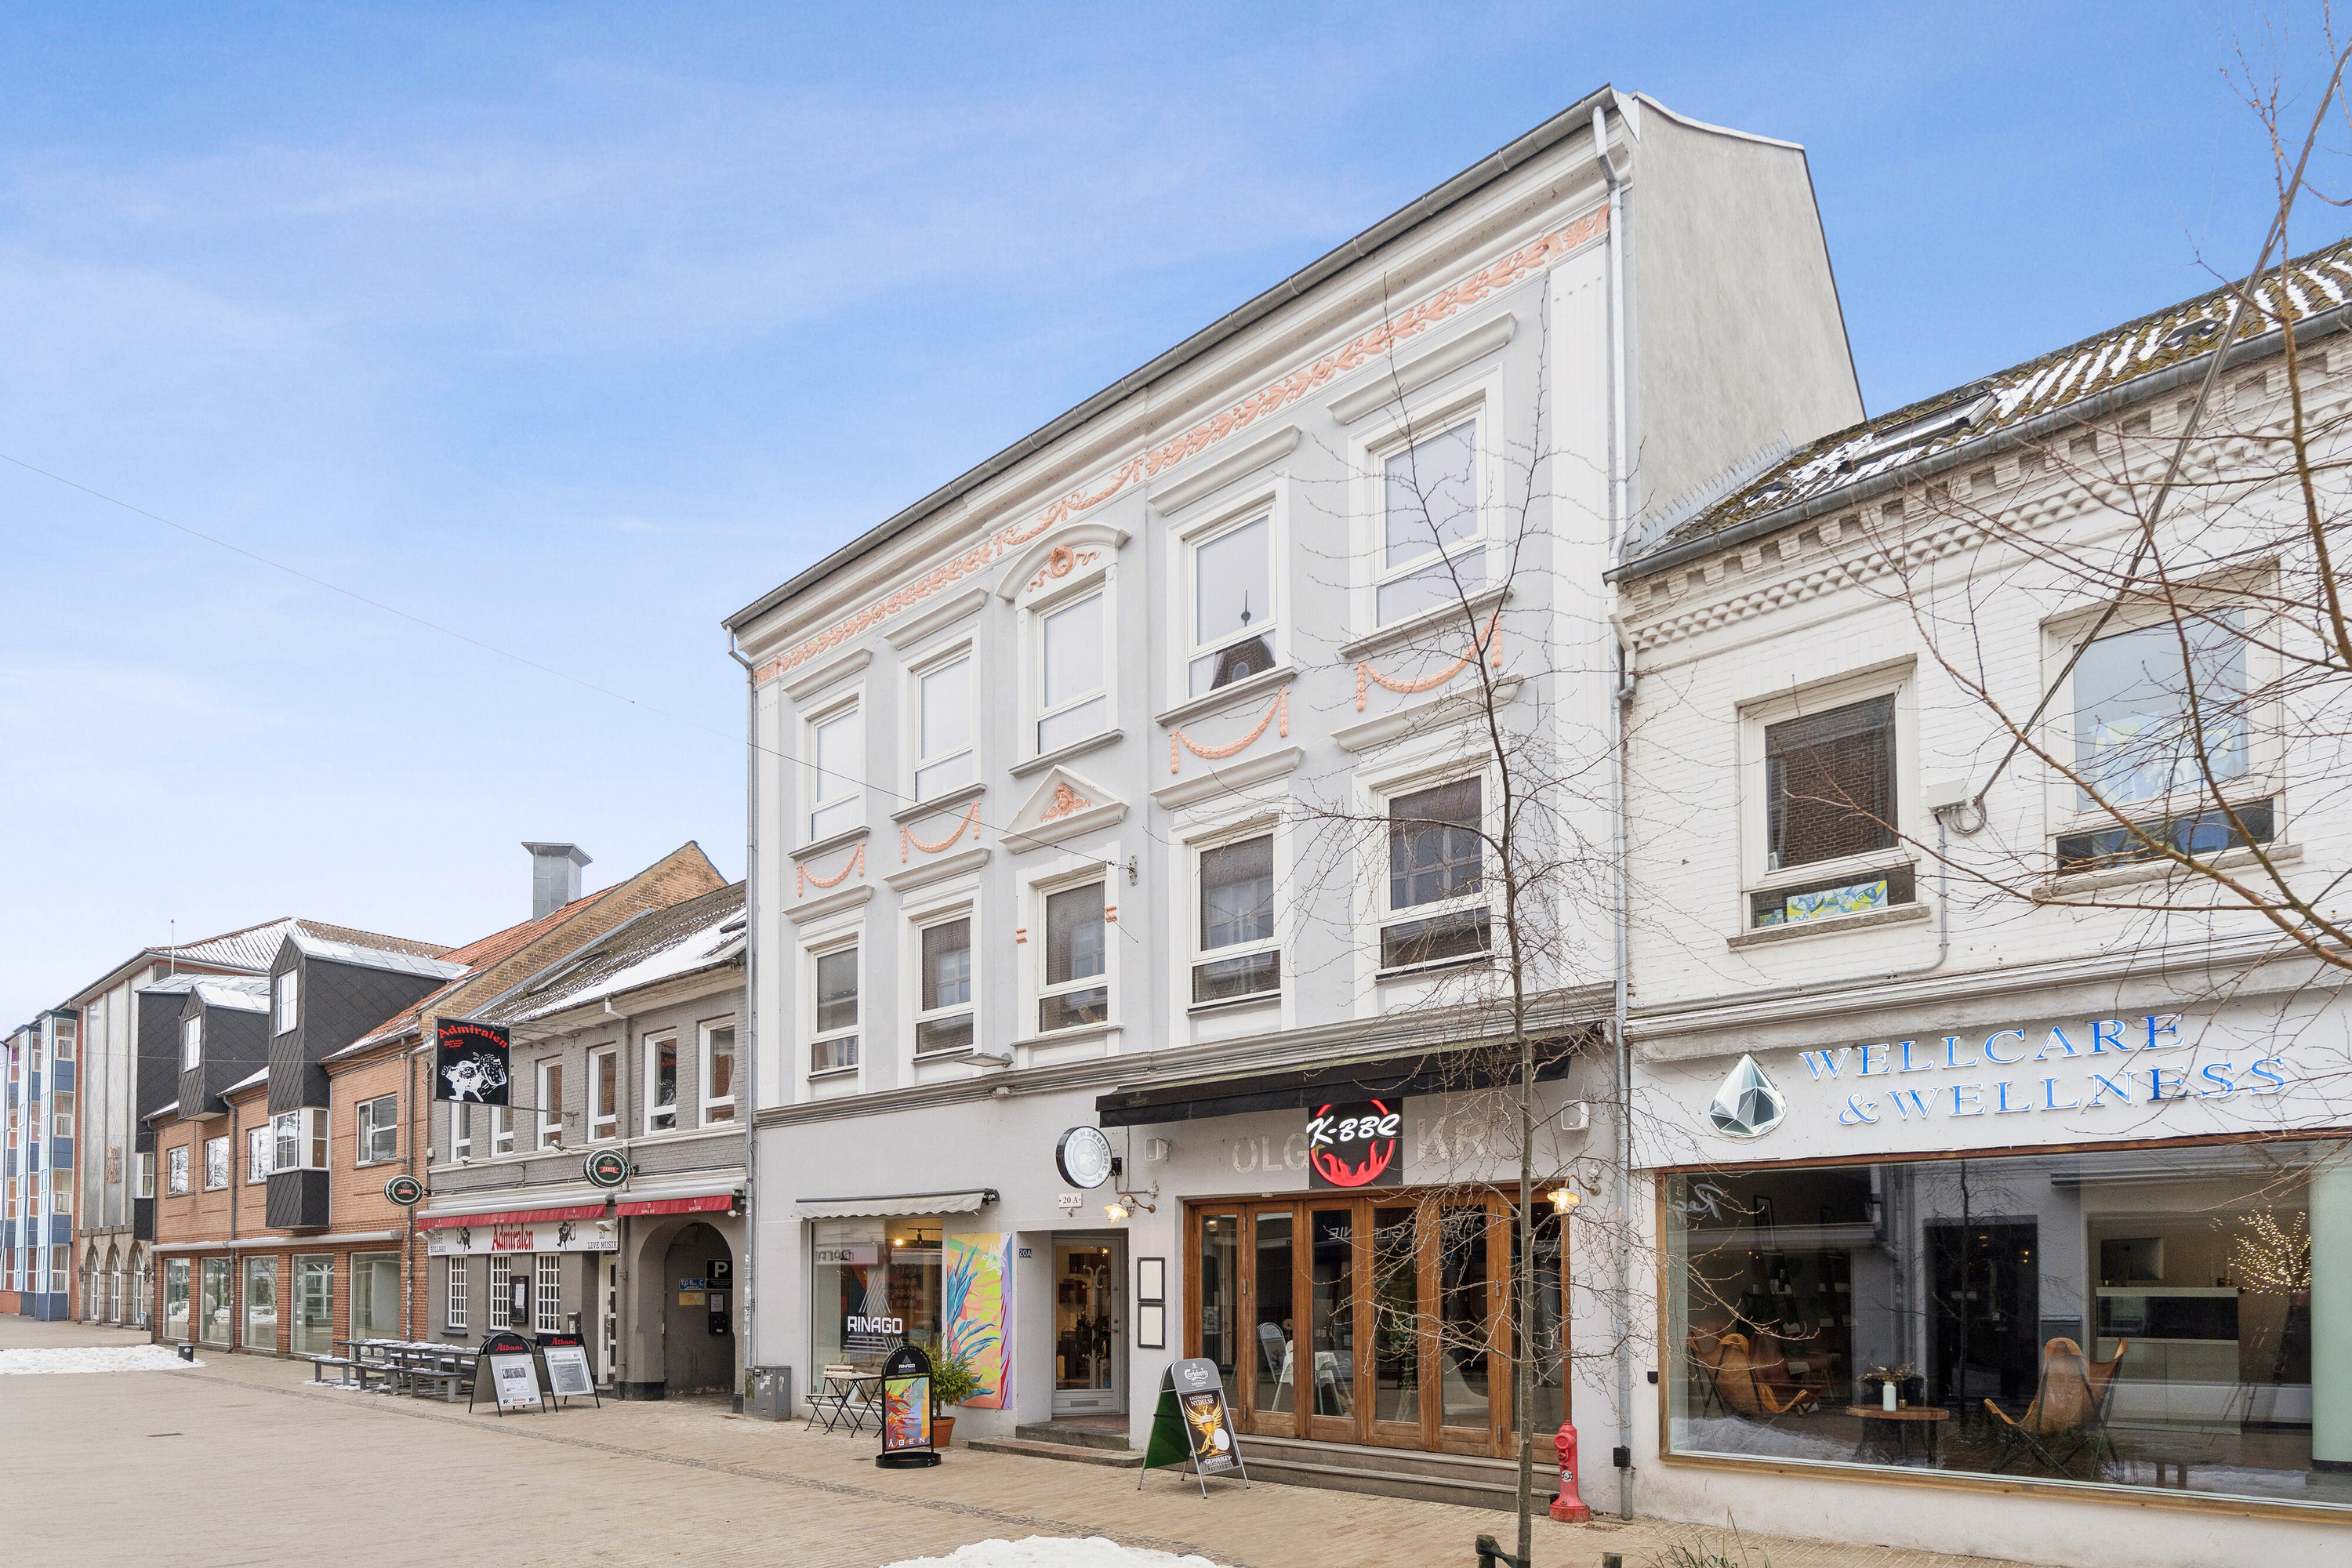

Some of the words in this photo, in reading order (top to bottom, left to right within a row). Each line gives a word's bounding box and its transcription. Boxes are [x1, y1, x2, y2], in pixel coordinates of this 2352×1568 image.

[437, 1024, 508, 1048] Admiralen
[1798, 1014, 2186, 1081] WELLCARE
[492, 1223, 534, 1251] Admiralen
[1019, 1249, 1032, 1258] 20A
[715, 1261, 728, 1278] P
[848, 1316, 902, 1334] RINAGO
[495, 1342, 524, 1352] Albani
[550, 1337, 578, 1345] Albani
[1184, 1367, 1209, 1380] Carlsberg
[1190, 1398, 1214, 1406] NYDELSE
